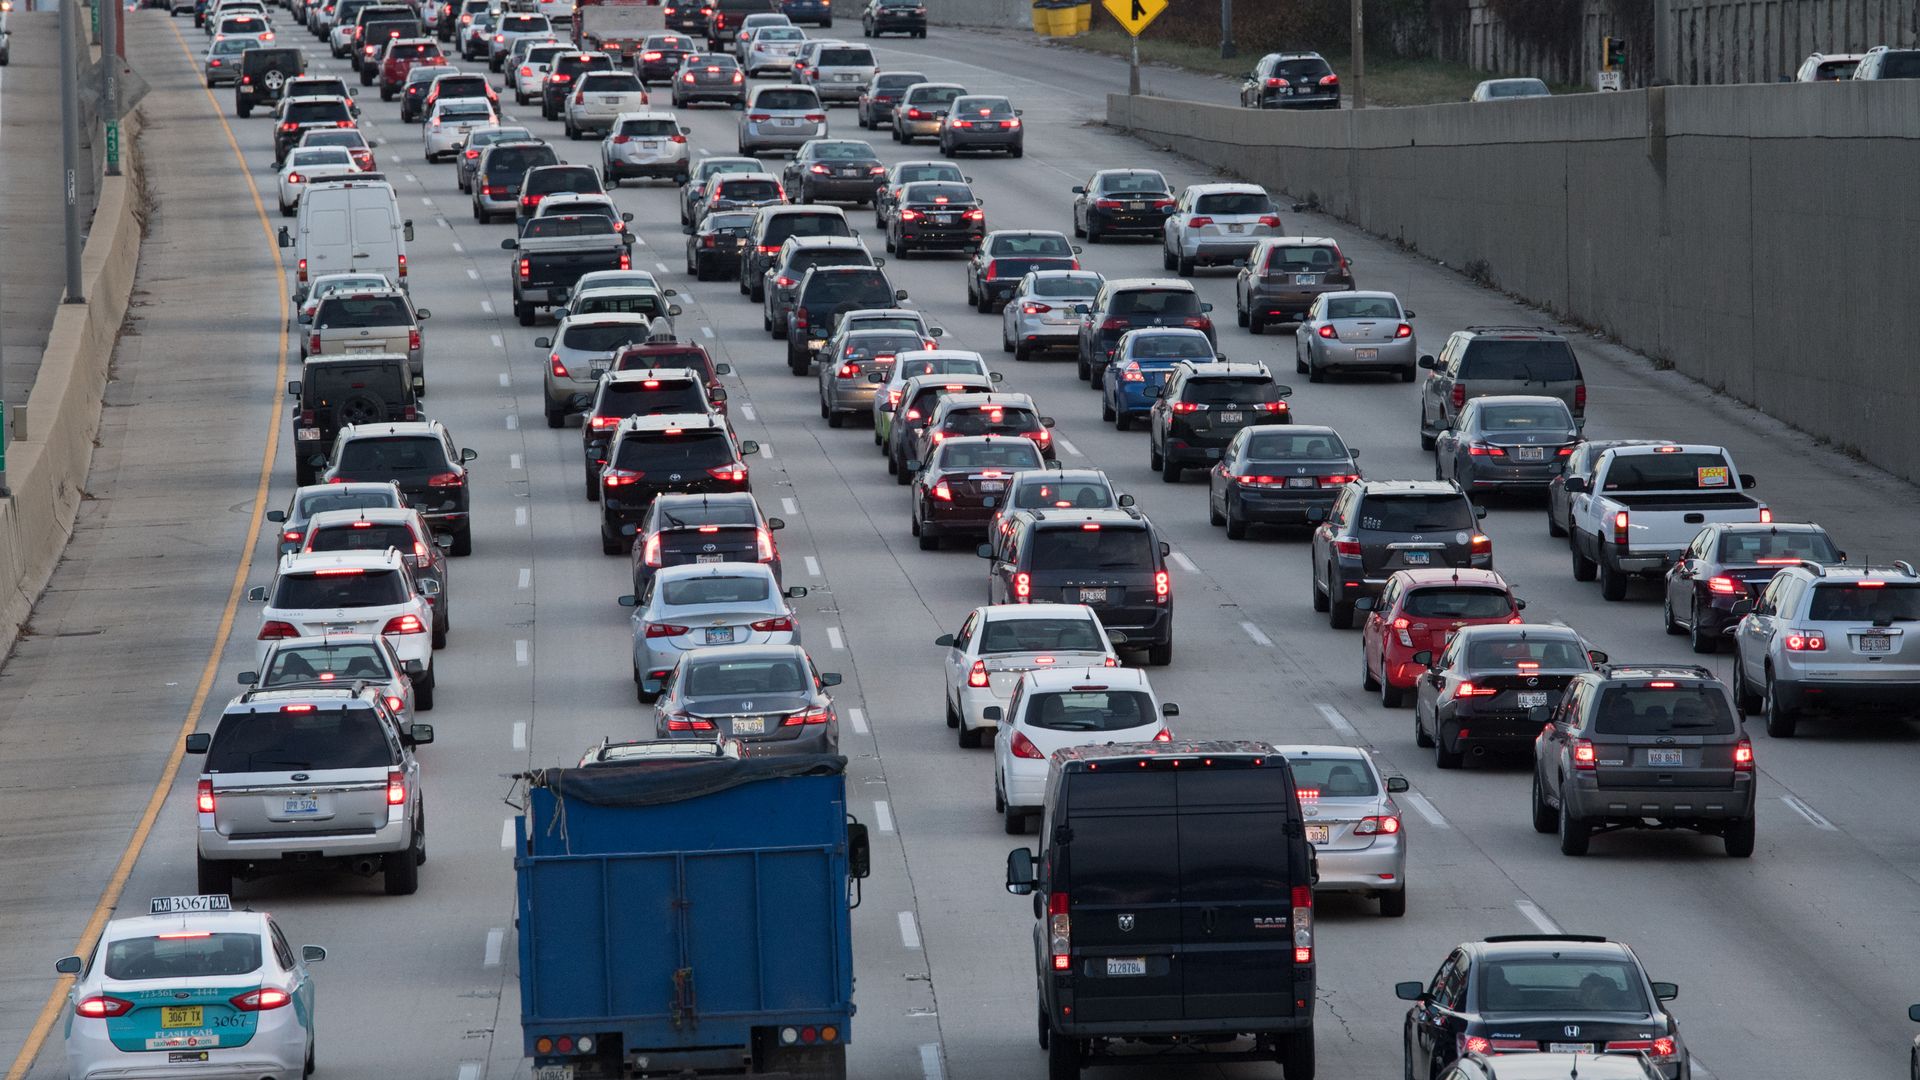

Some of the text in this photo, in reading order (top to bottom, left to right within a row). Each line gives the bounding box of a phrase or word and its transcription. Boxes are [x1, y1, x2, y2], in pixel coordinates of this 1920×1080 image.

[153, 898, 228, 911] TAXI 3067 TAXI
[169, 1010, 200, 1021] 3067 TX
[212, 1015, 248, 1027] 3067
